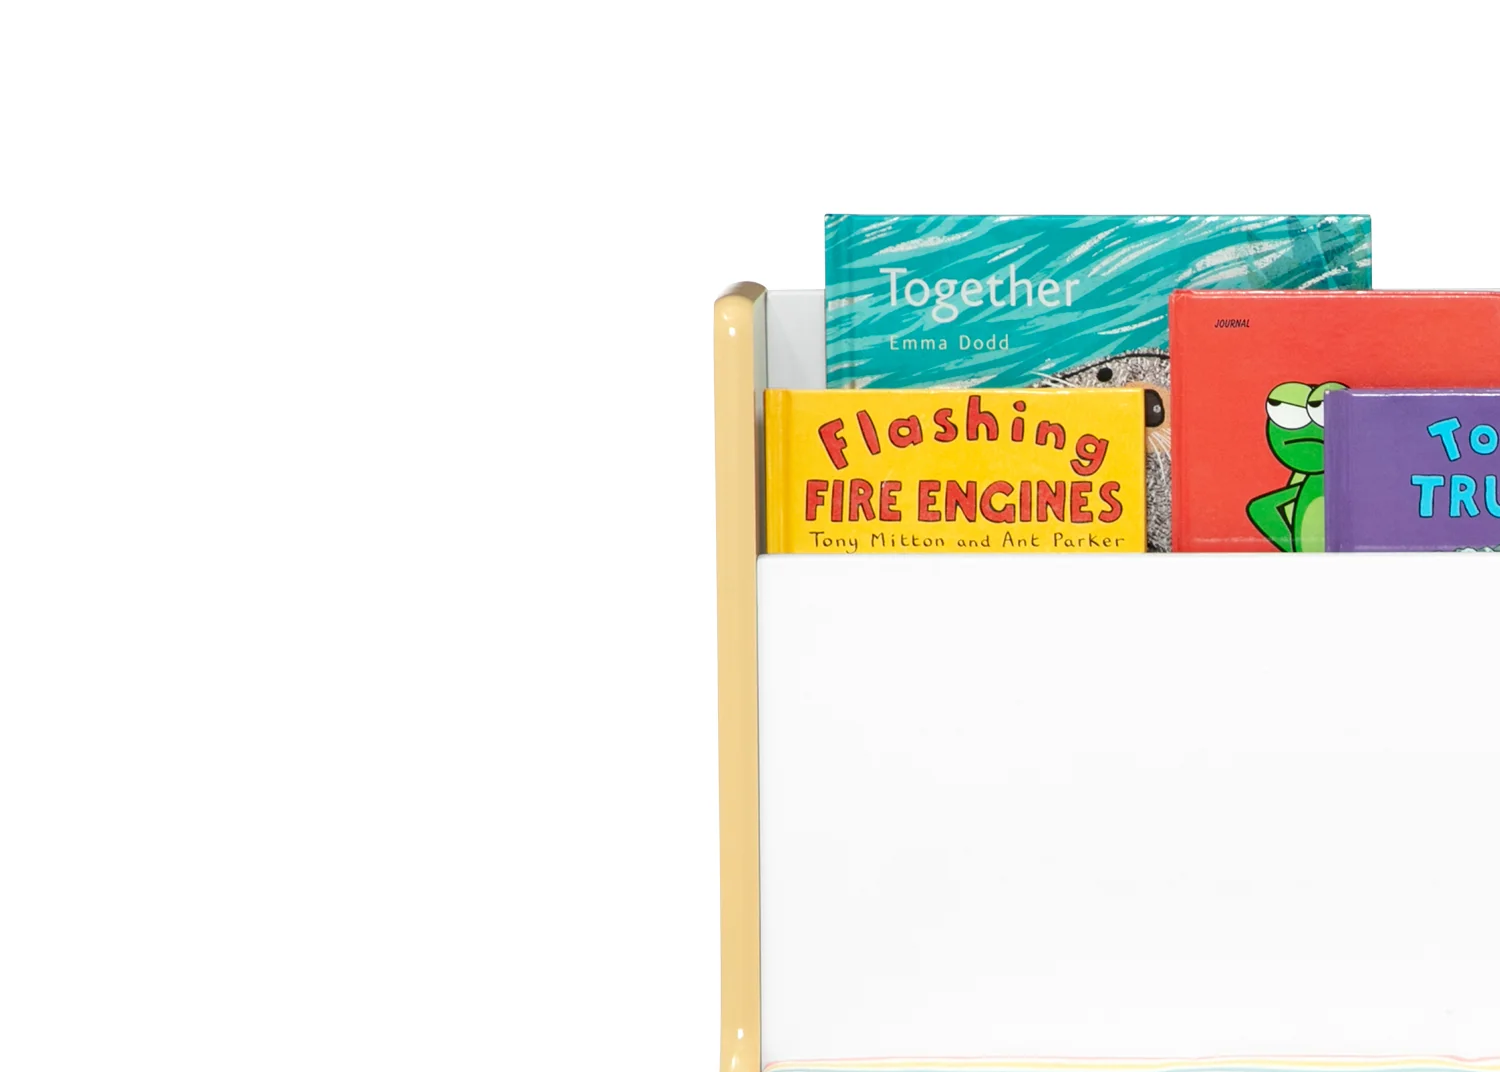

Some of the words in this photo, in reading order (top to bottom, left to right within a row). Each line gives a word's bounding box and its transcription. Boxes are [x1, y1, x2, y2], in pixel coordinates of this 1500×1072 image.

[879, 263, 1080, 323] Together
[1214, 318, 1250, 329] JOURNAL
[889, 335, 948, 350] Emma
[959, 334, 1010, 350] Dodd
[818, 395, 1110, 477] Flashing
[804, 478, 902, 523] FIRE
[917, 478, 1124, 524] ENGINES
[809, 530, 858, 553] Tony
[871, 532, 945, 548] Mitton
[956, 534, 991, 548] and
[1001, 530, 1041, 548] Ant
[1053, 531, 1126, 549] Parker
